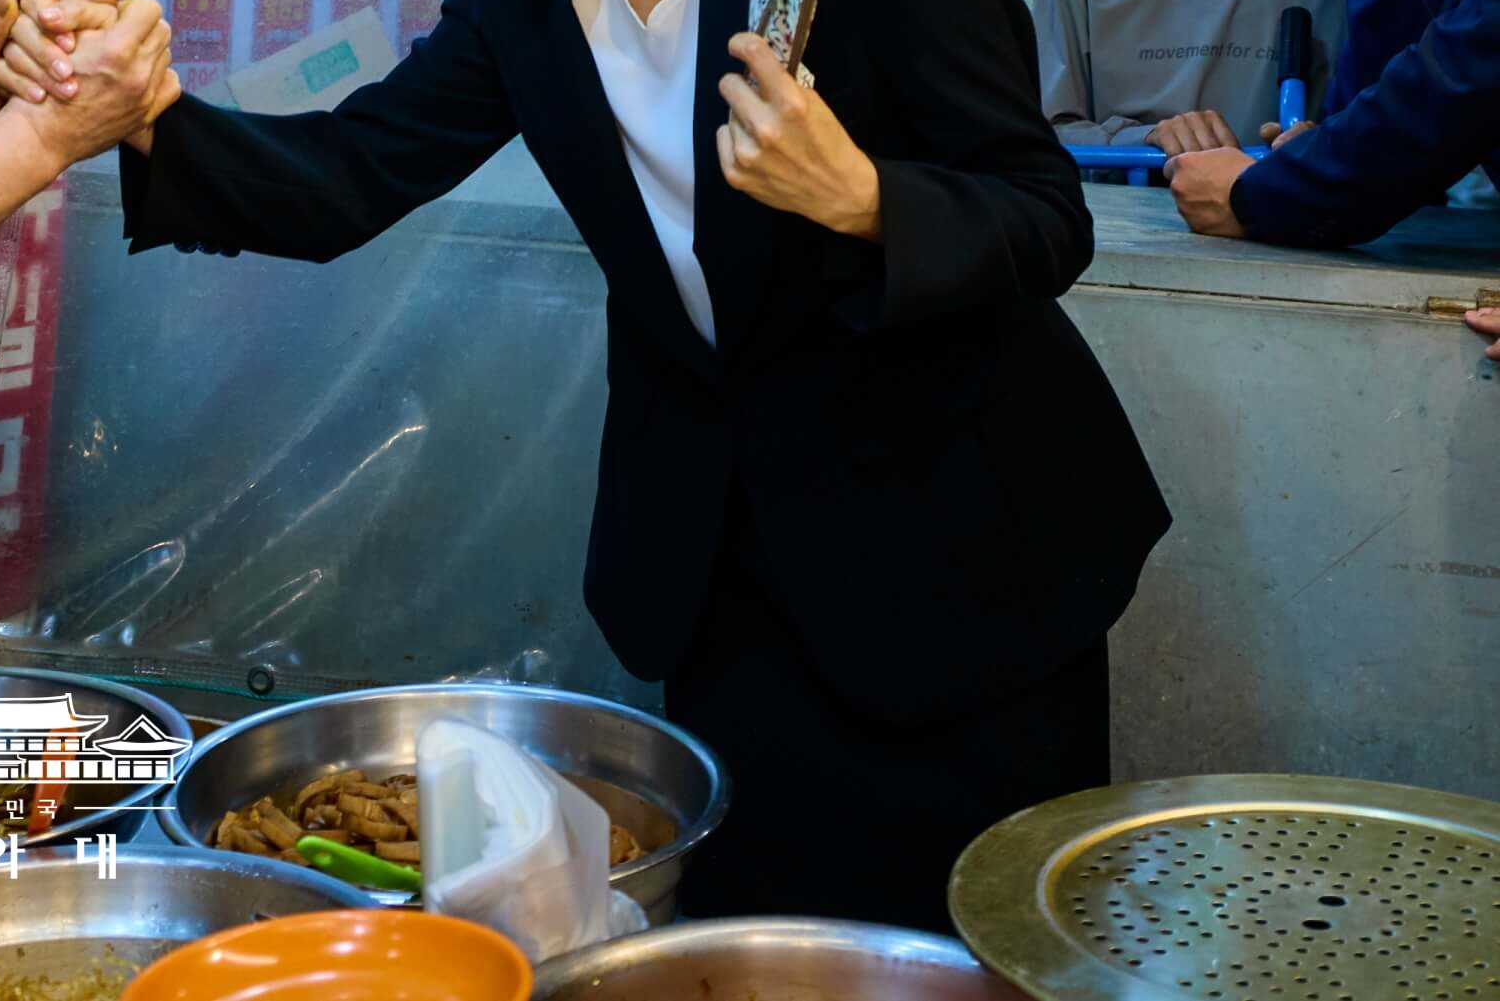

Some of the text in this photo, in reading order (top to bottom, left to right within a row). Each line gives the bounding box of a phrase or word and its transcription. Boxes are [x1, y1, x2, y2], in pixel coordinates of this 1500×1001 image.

[1139, 42, 1280, 62] movement for ch
